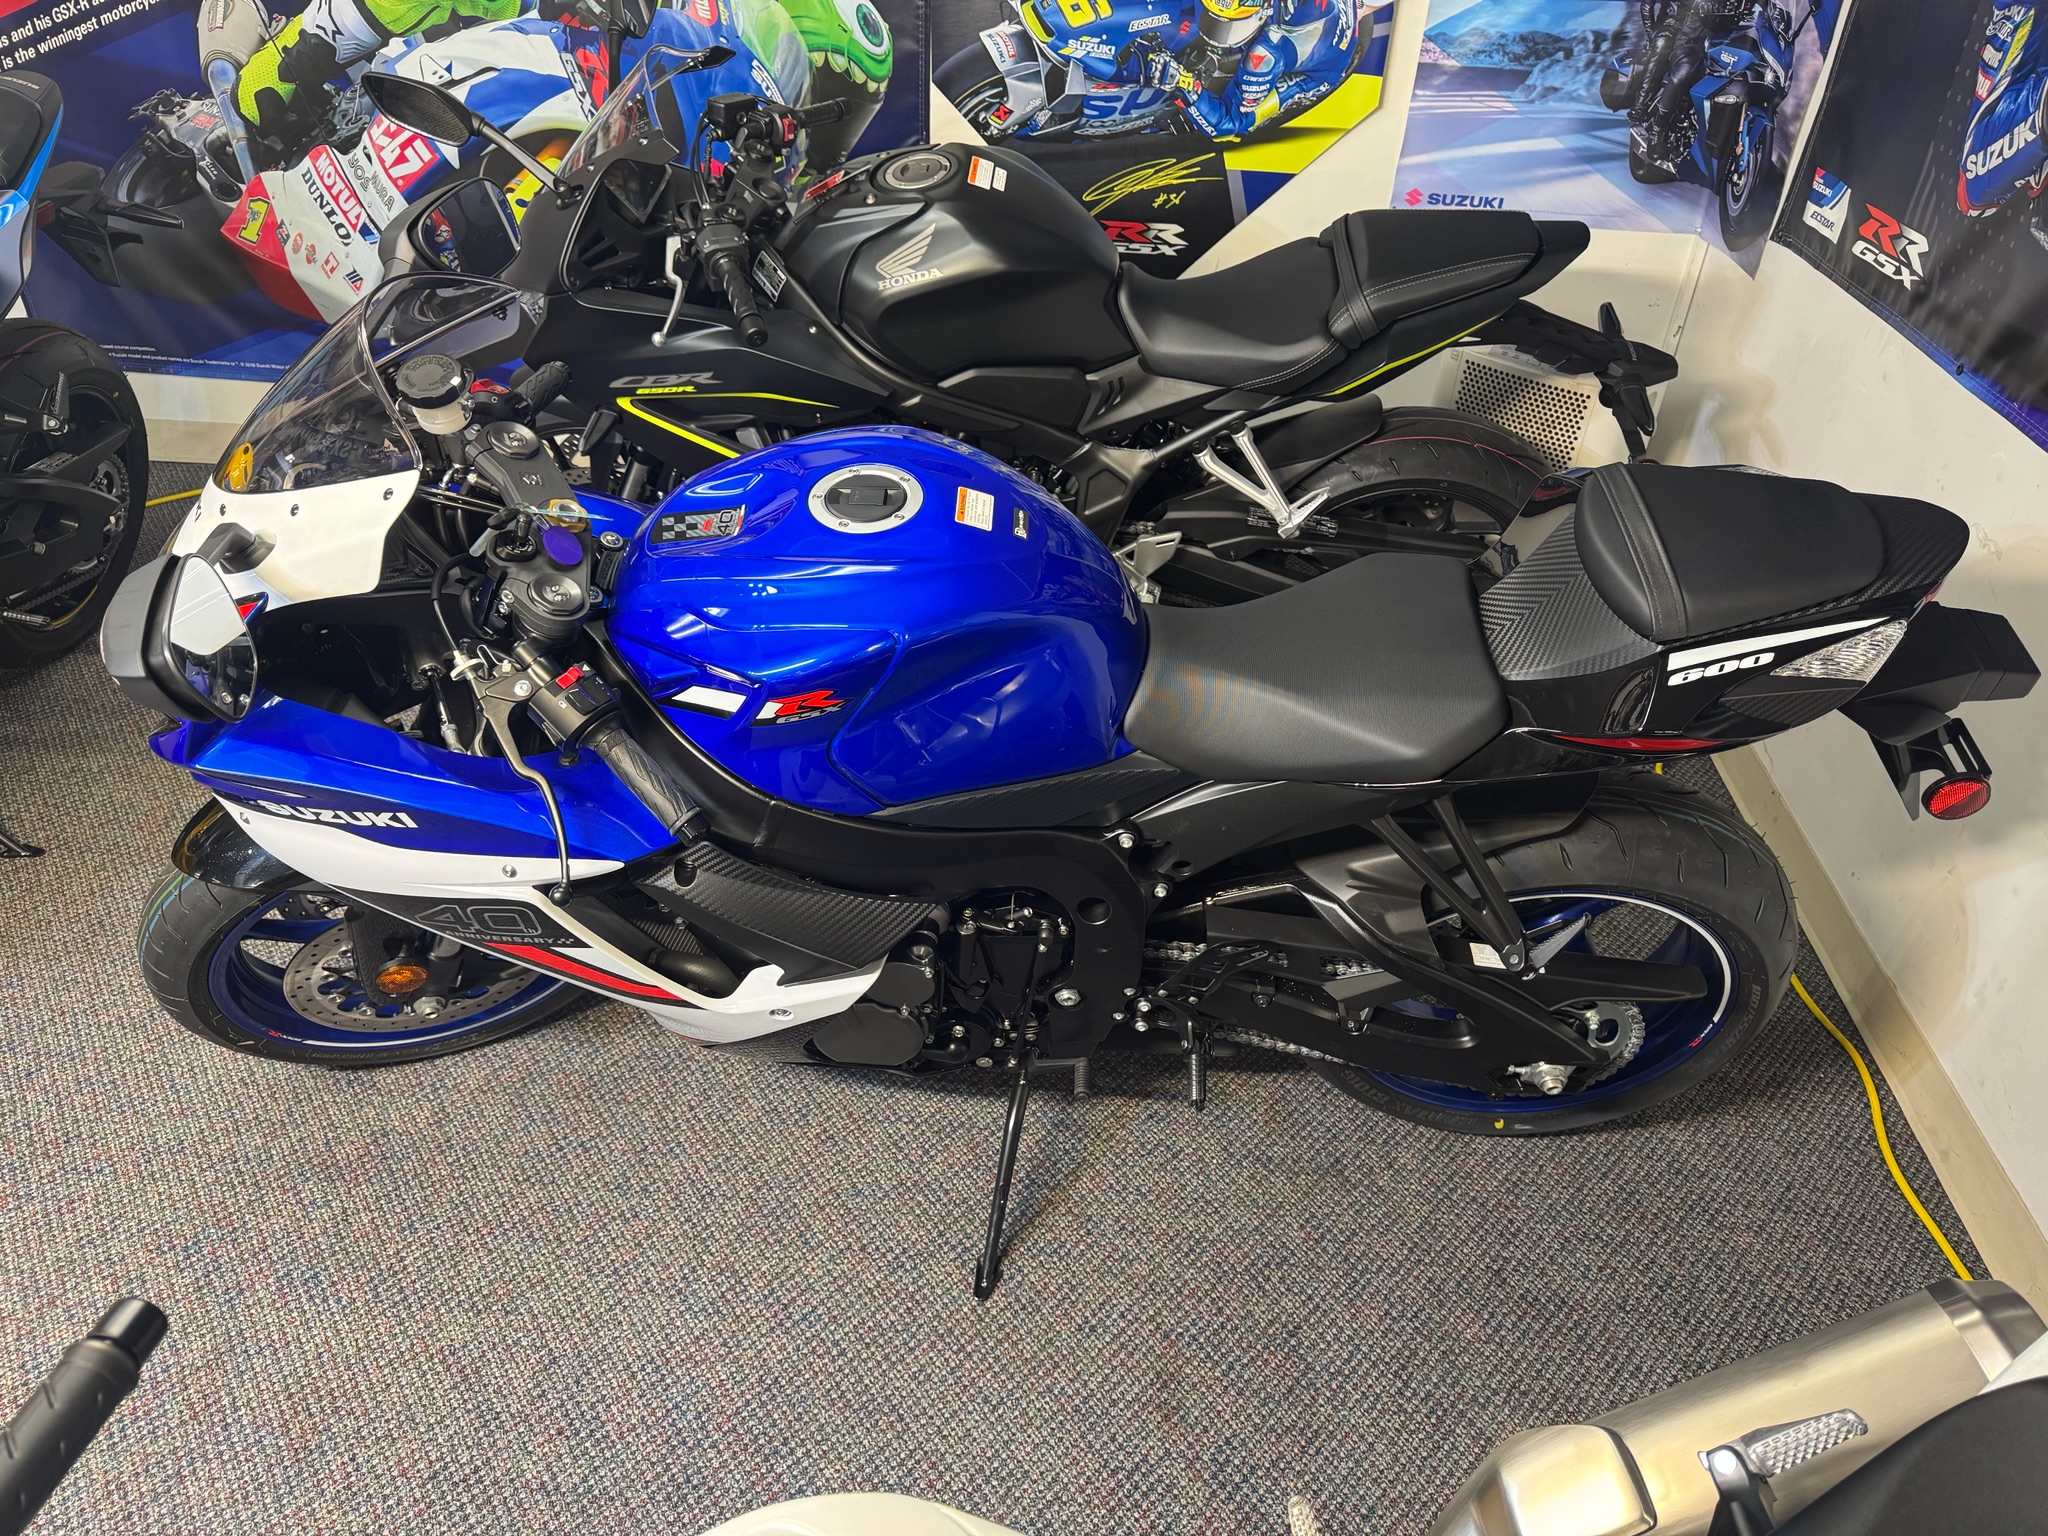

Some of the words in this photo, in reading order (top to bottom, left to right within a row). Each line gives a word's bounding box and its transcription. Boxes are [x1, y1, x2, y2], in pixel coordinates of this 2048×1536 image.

[11, 20, 34, 42] and
[34, 14, 52, 32] his
[52, 0, 90, 23] GSX-R
[1, 56, 14, 70] is
[14, 47, 36, 64] the
[37, 16, 99, 54] winningest
[100, 0, 160, 26] motorcy
[987, 34, 1006, 63] SUZUKI
[1067, 40, 1116, 55] SUZUKI
[1241, 83, 1270, 92] SUZUKI
[1188, 105, 1217, 136] SUZUKI
[315, 152, 363, 225] MOTUL
[1812, 181, 1833, 198] SUZUKI
[301, 167, 354, 247] DUNLO
[1427, 193, 1504, 209] SUZUKI
[1810, 211, 1835, 233] ECSTAR
[1851, 240, 1921, 291] GSX
[877, 267, 944, 291] HONDA
[609, 371, 724, 388] CBR
[636, 386, 697, 394] 650R
[1667, 652, 1775, 686] 600
[776, 702, 846, 724] GSX
[257, 800, 418, 828] SUZUKI
[445, 930, 556, 944] ANNIVERSARY
